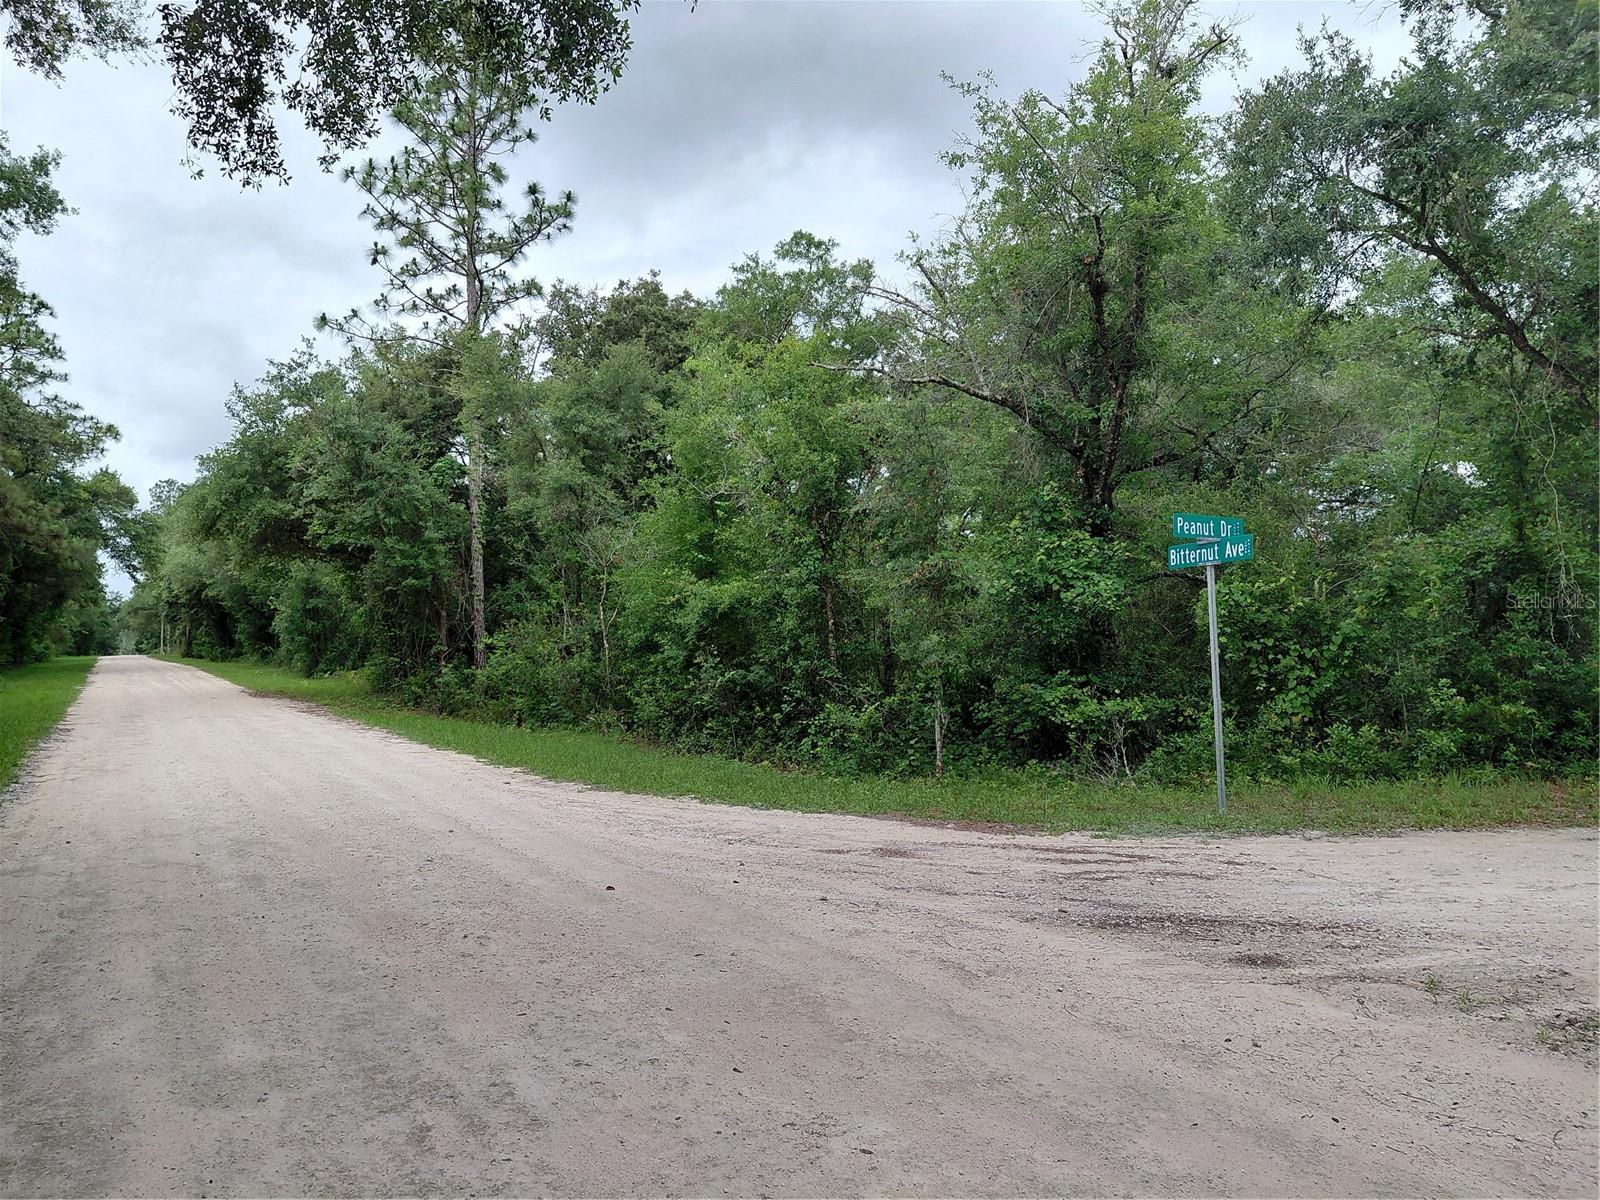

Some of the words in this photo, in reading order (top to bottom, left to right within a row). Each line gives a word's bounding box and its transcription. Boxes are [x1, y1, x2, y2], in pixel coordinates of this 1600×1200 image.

[1177, 517, 1214, 536] Peanut
[1220, 520, 1232, 537] Dr
[1170, 543, 1219, 565] Bitternut
[1225, 541, 1244, 558] Ave
